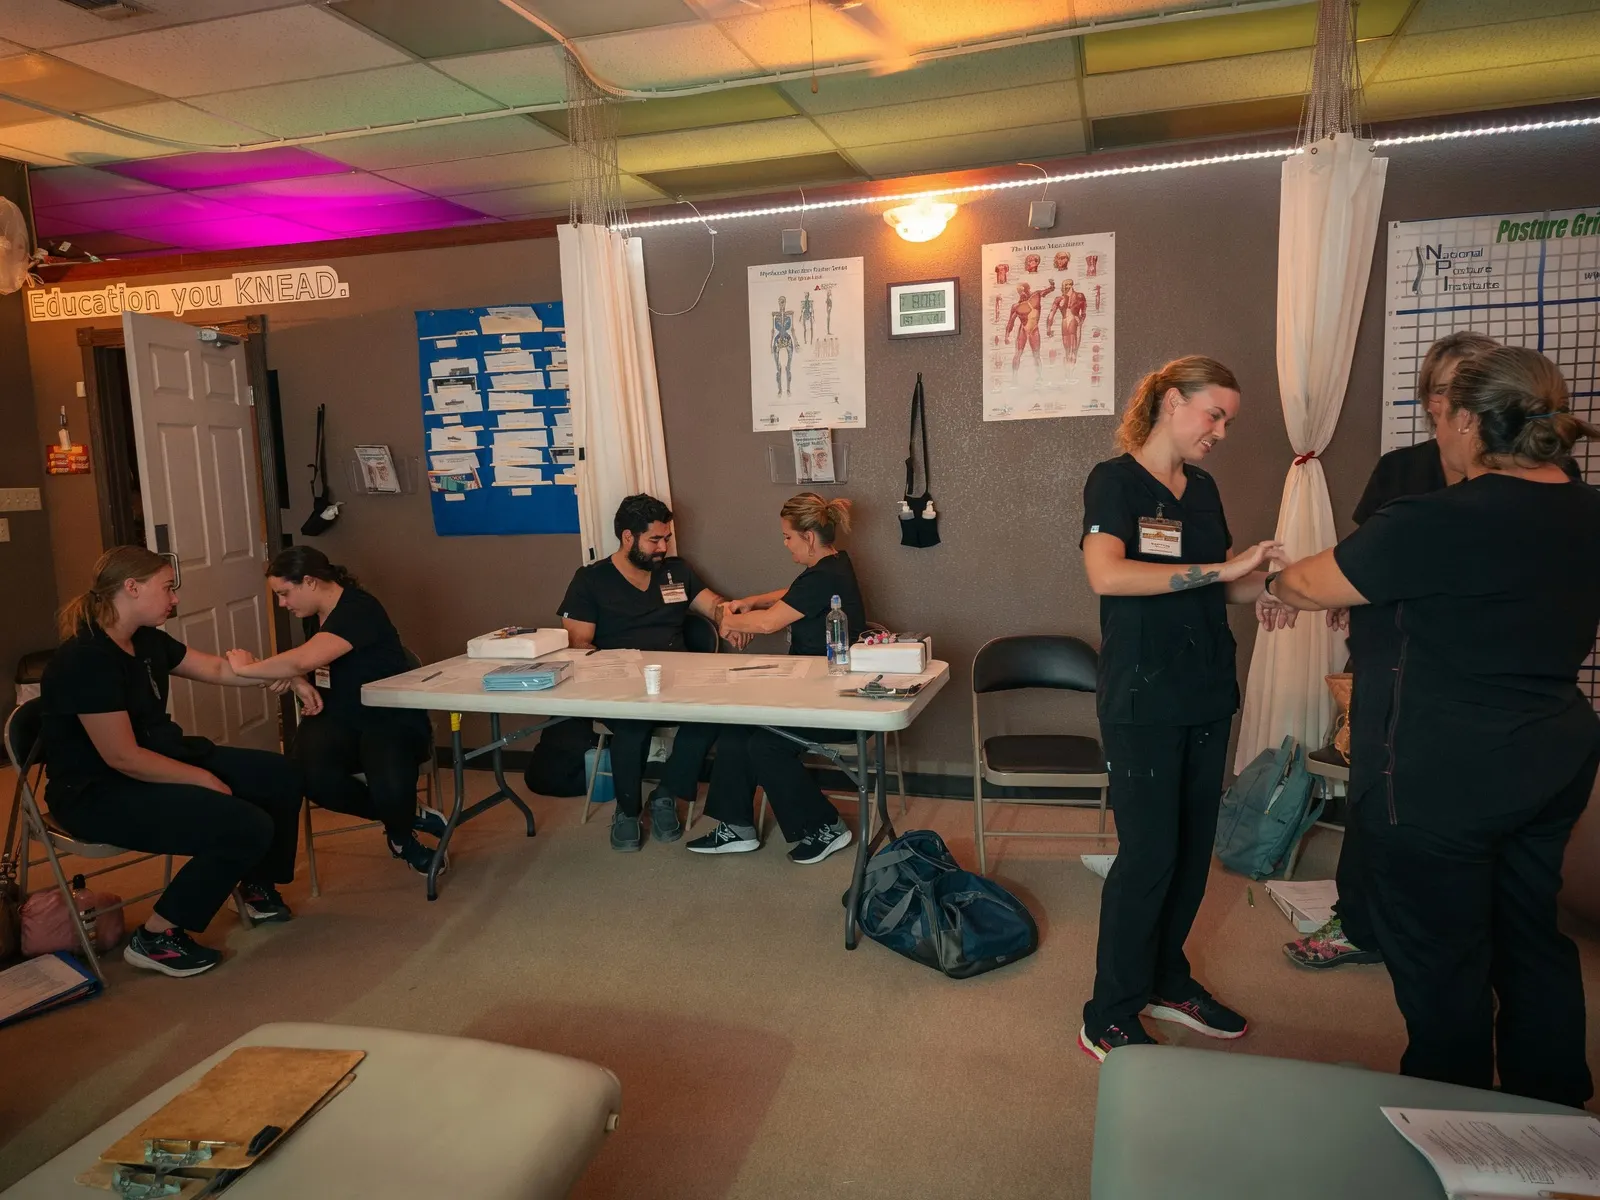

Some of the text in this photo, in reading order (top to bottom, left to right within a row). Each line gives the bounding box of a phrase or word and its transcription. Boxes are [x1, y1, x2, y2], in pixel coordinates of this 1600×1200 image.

[1496, 211, 1600, 243] Posture Gri
[1425, 244, 1484, 260] National
[1435, 260, 1493, 276] Posture
[1444, 276, 1500, 292] Institute
[30, 271, 347, 319] Education you KNEAD.
